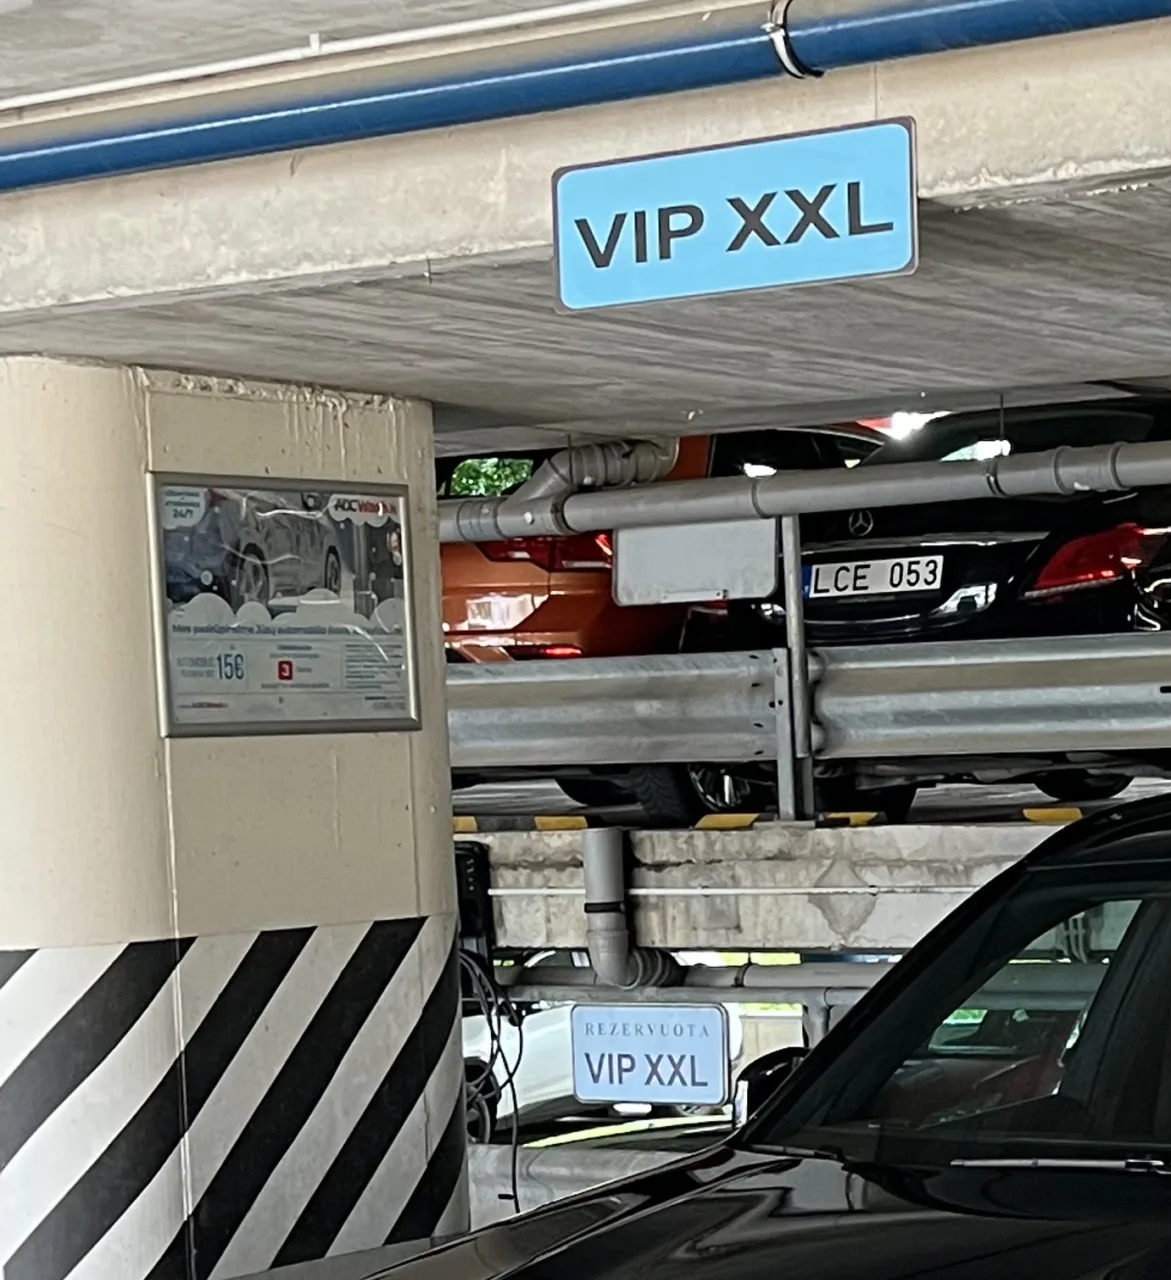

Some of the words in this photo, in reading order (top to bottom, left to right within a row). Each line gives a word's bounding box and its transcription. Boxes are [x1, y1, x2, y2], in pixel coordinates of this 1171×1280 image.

[574, 204, 704, 269] VIP
[725, 181, 894, 252] XXL
[813, 564, 871, 594] LCE
[889, 559, 938, 588] 053
[585, 1022, 710, 1037] REZERVUOTA
[584, 1053, 636, 1085] VIP
[644, 1054, 708, 1087] XXL
